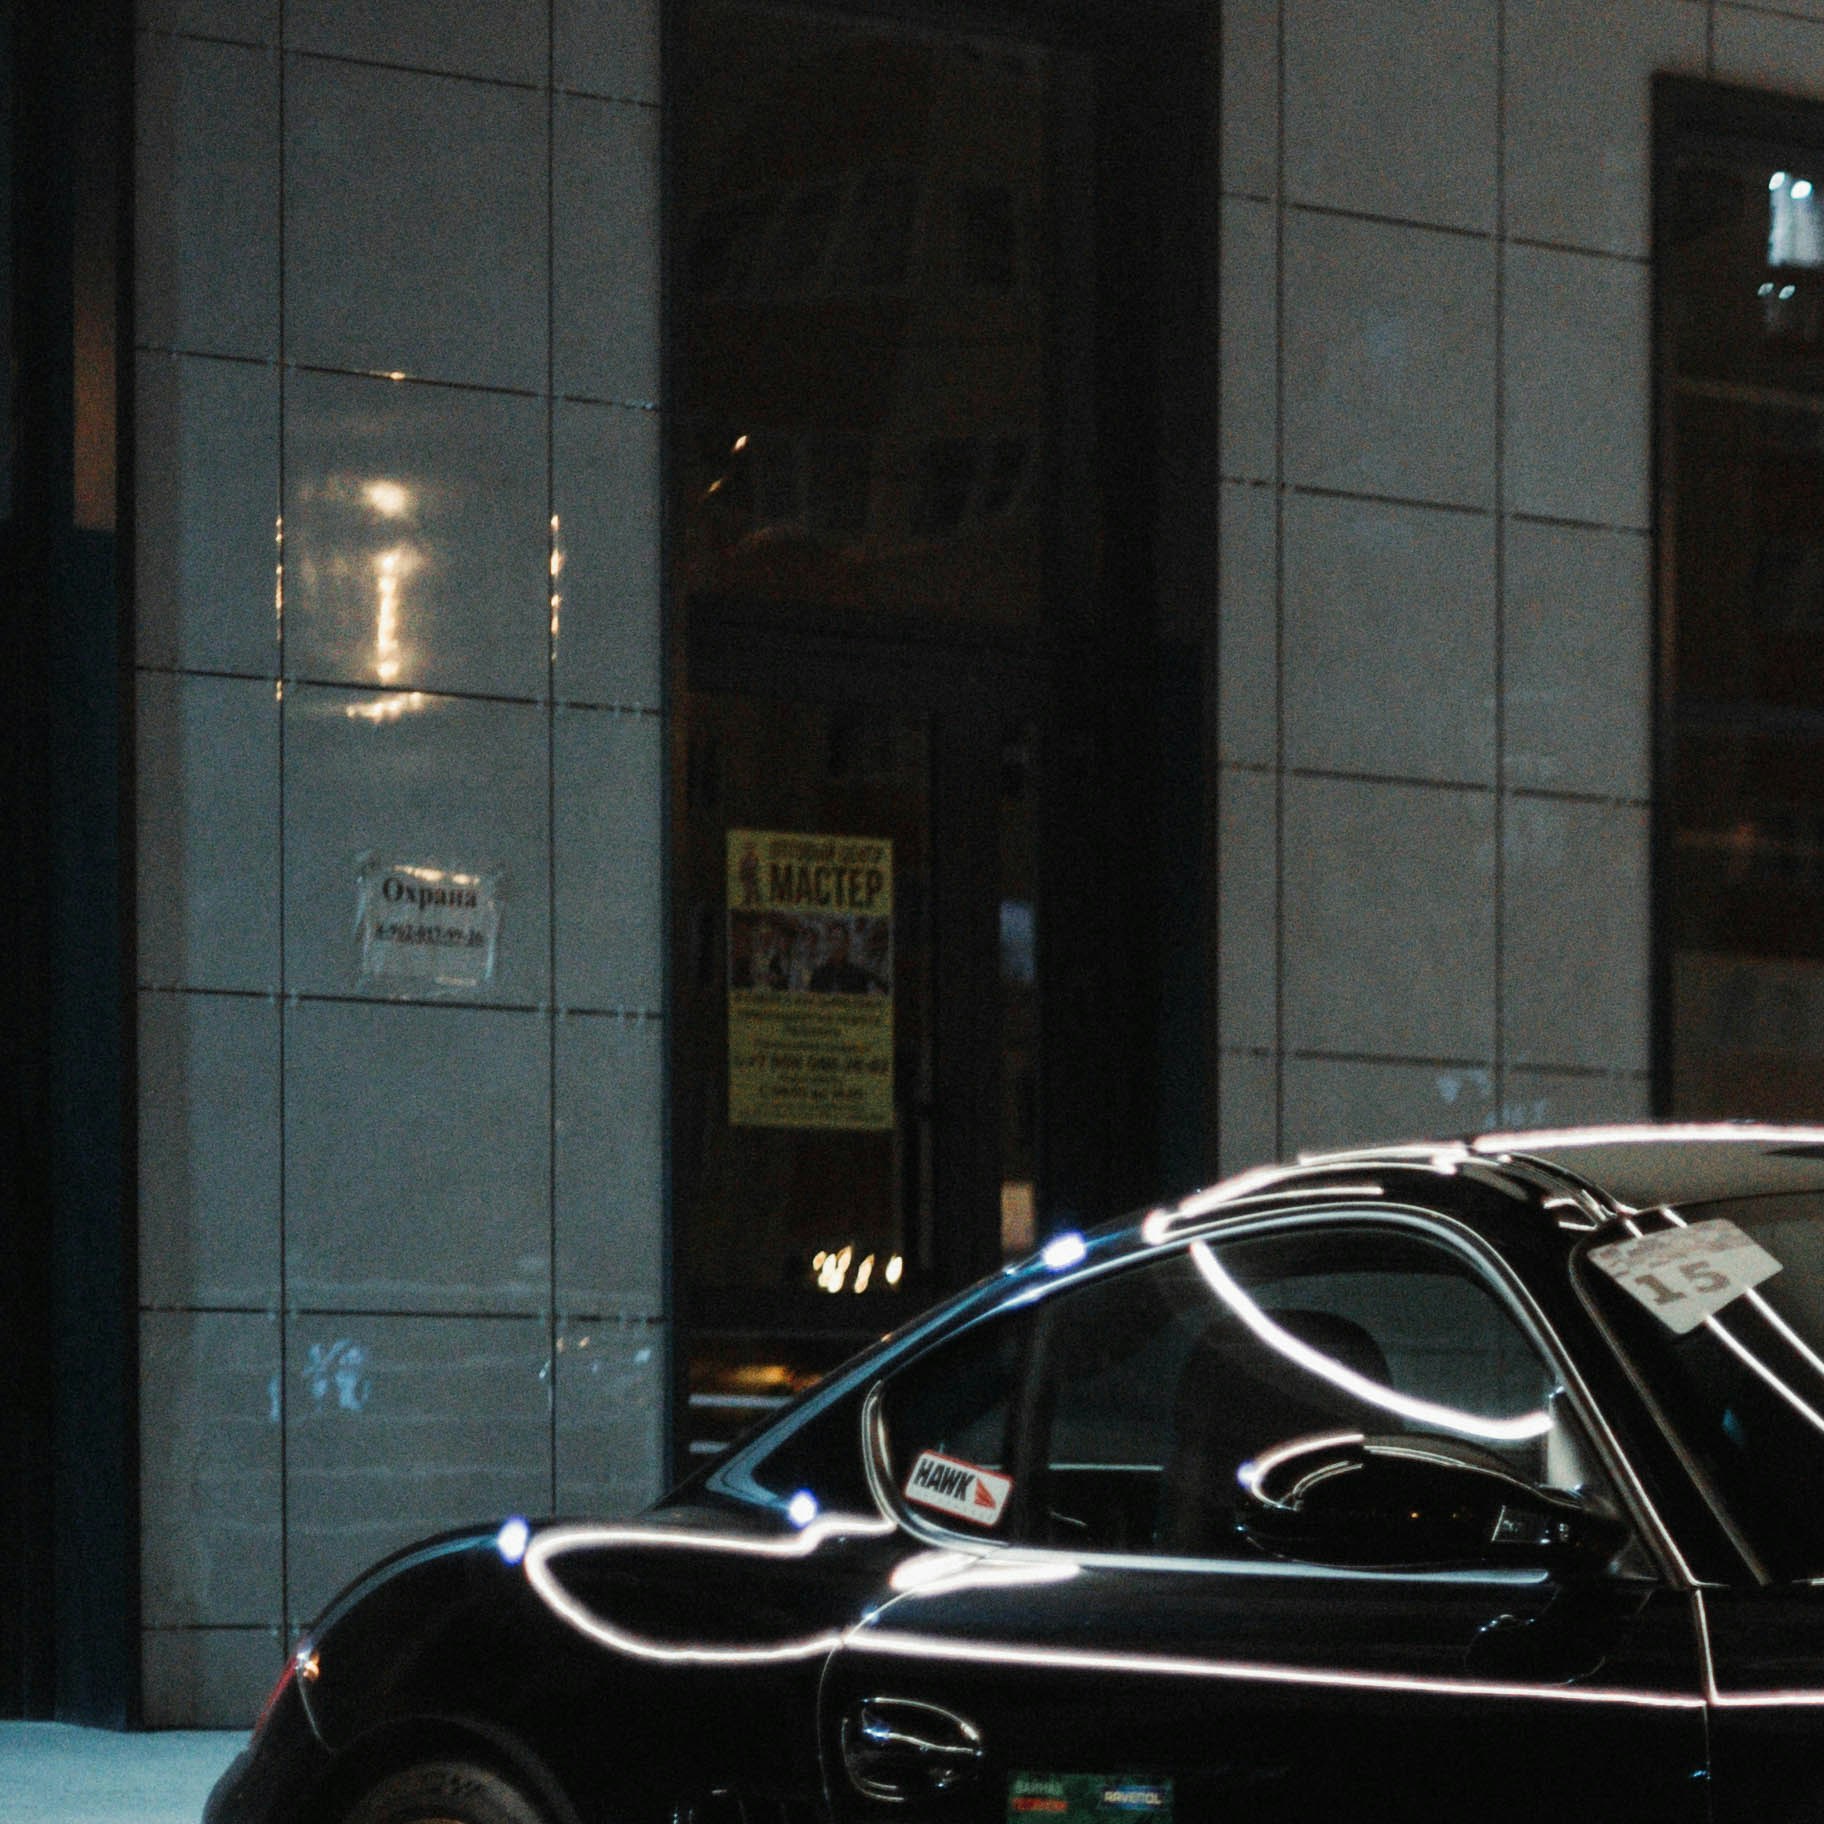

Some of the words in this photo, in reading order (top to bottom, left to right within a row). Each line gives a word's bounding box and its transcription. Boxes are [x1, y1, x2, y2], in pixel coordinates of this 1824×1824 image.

[382, 878, 478, 910] Охрана
[769, 863, 883, 908] МАСТЕР
[1634, 1260, 1731, 1305] 15
[913, 1458, 976, 1502] HAWK
